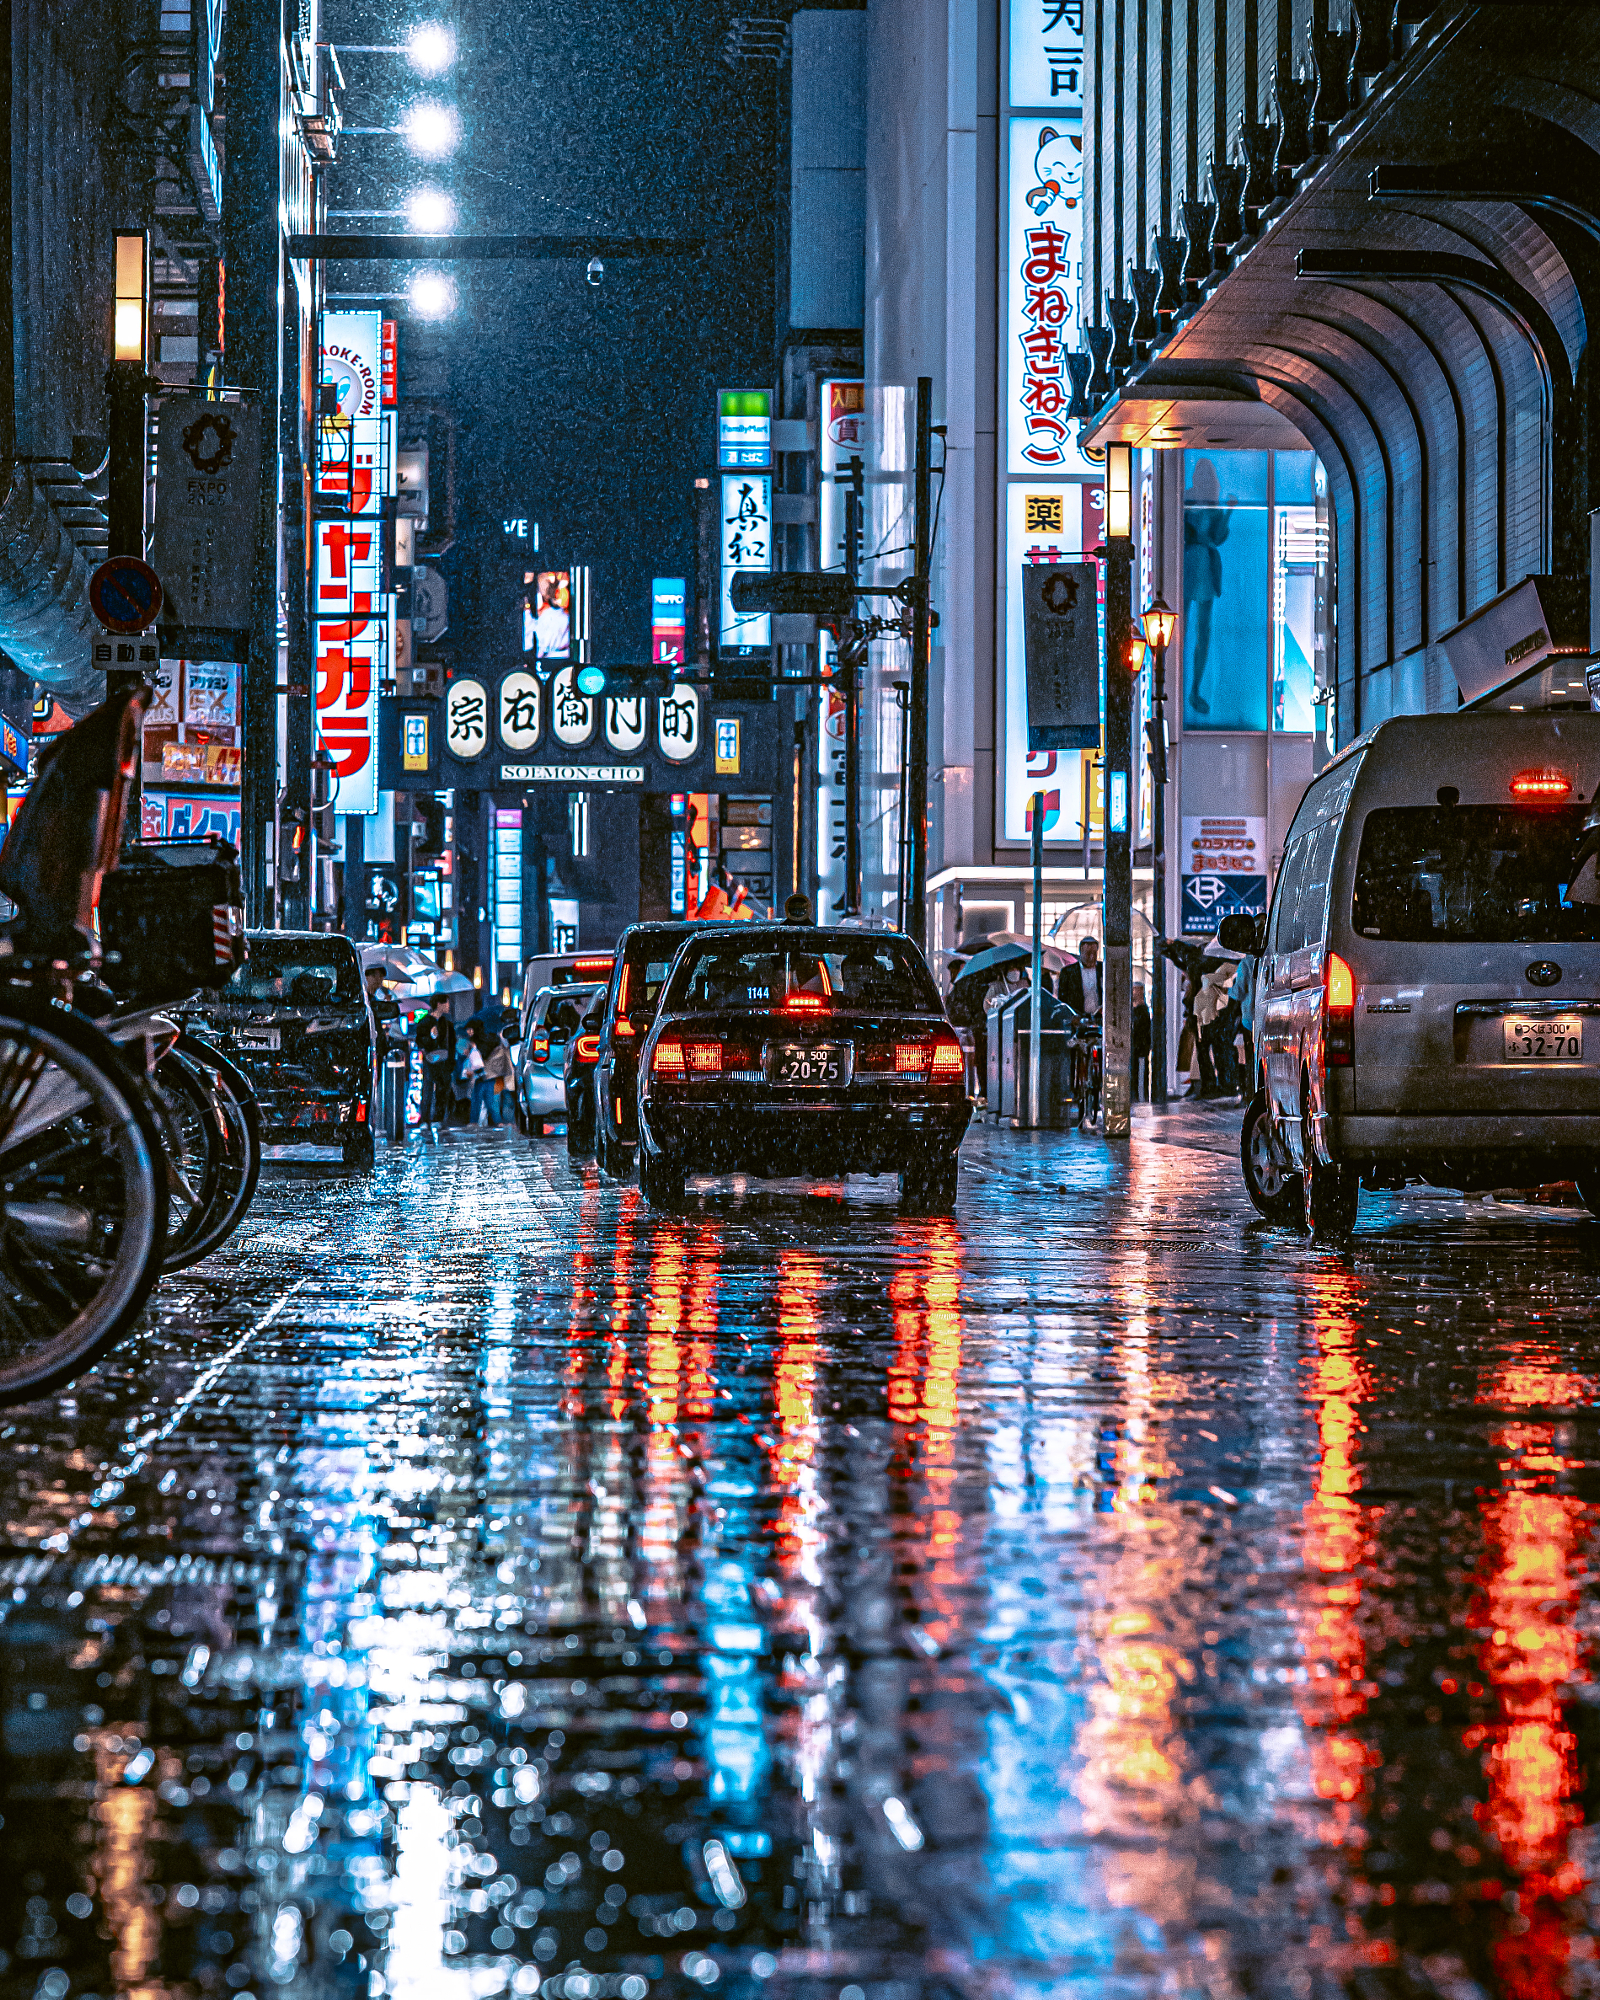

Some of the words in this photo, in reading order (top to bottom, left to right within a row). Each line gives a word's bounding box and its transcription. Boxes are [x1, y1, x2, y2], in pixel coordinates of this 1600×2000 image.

[1020, 221, 1072, 466] まねきねこ
[1027, 497, 1061, 531] 薬
[317, 454, 372, 778] ジャンカラ
[96, 644, 156, 663] 自動車
[189, 689, 228, 710] EX
[504, 767, 641, 780] SOEMON-CHO
[747, 987, 769, 999] 1144
[1522, 1024, 1546, 1034] つくば
[1546, 1023, 1565, 1034] 300
[810, 1051, 828, 1061] 500
[1522, 1037, 1579, 1056] 32-70
[790, 1061, 838, 1079] 20-75
